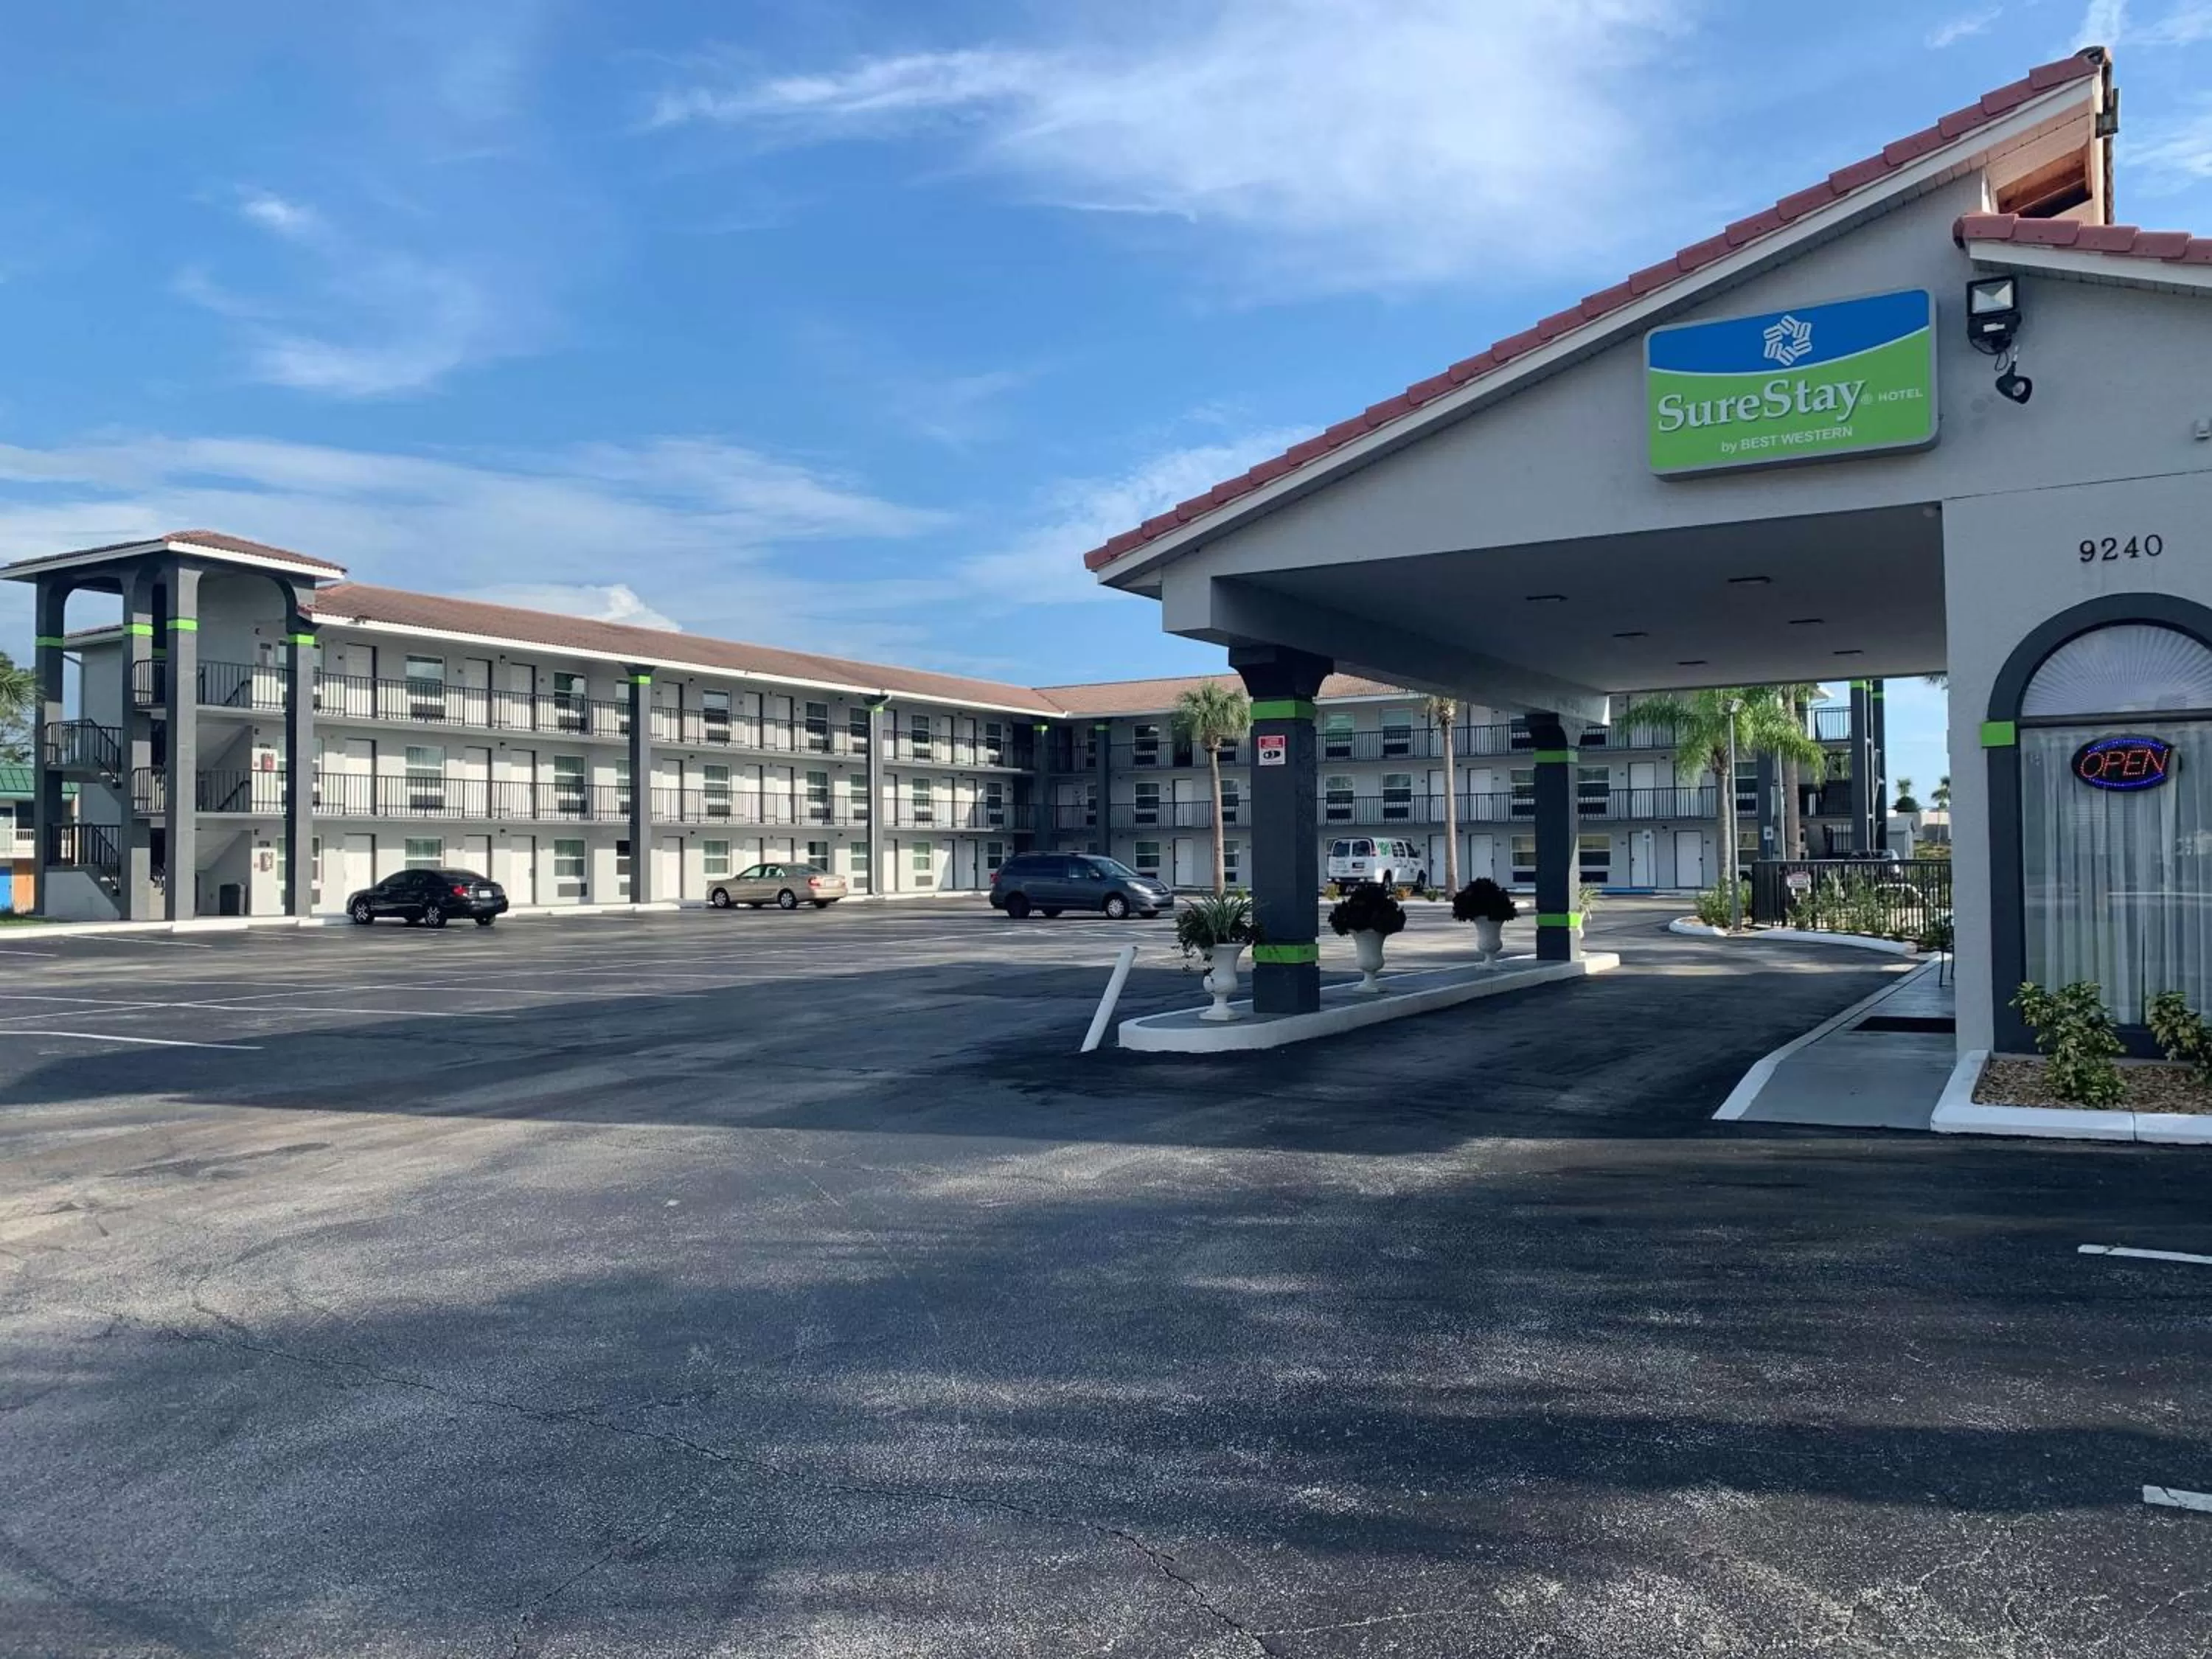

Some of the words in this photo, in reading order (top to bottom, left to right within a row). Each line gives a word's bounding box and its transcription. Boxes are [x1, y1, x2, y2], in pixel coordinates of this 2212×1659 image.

[1658, 379, 1865, 431] SureStay
[1878, 388, 1923, 402] HOTEL
[1722, 440, 1737, 454] by
[1741, 435, 1779, 450] BEST
[1781, 426, 1853, 445] WESTERN
[2079, 535, 2163, 563] 9240
[2080, 749, 2168, 778] OPEN
